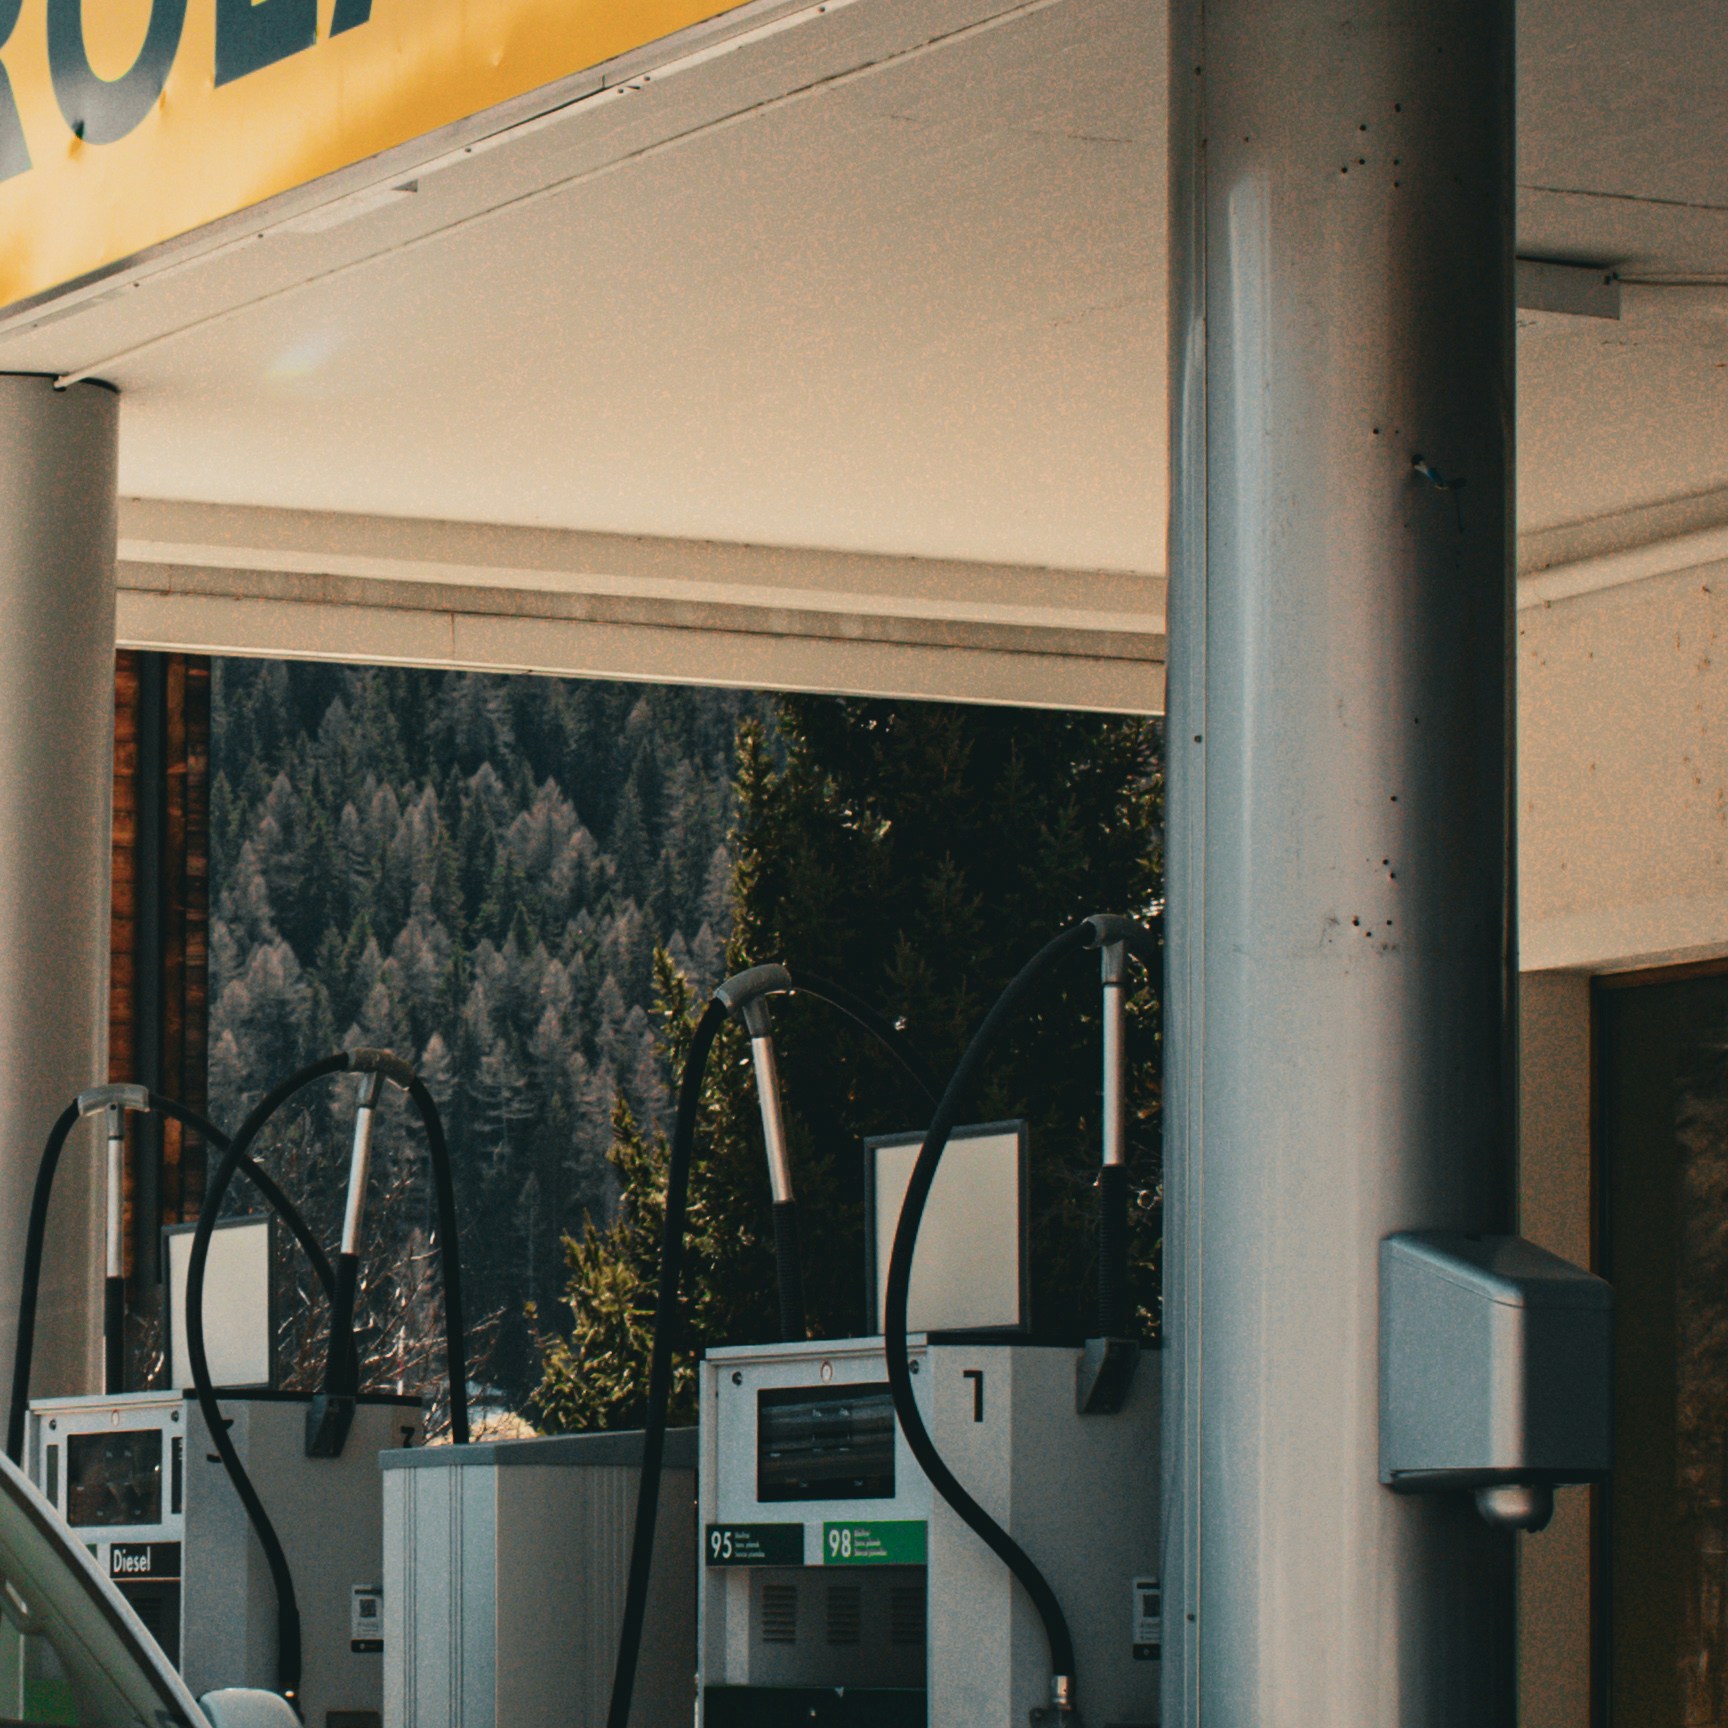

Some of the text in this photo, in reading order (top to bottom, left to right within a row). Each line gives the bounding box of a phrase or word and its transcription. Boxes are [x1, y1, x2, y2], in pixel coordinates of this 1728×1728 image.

[962, 1370, 983, 1422] 1
[710, 1531, 733, 1559] 95
[828, 1529, 852, 1558] 98
[113, 1546, 151, 1572] Diesel
